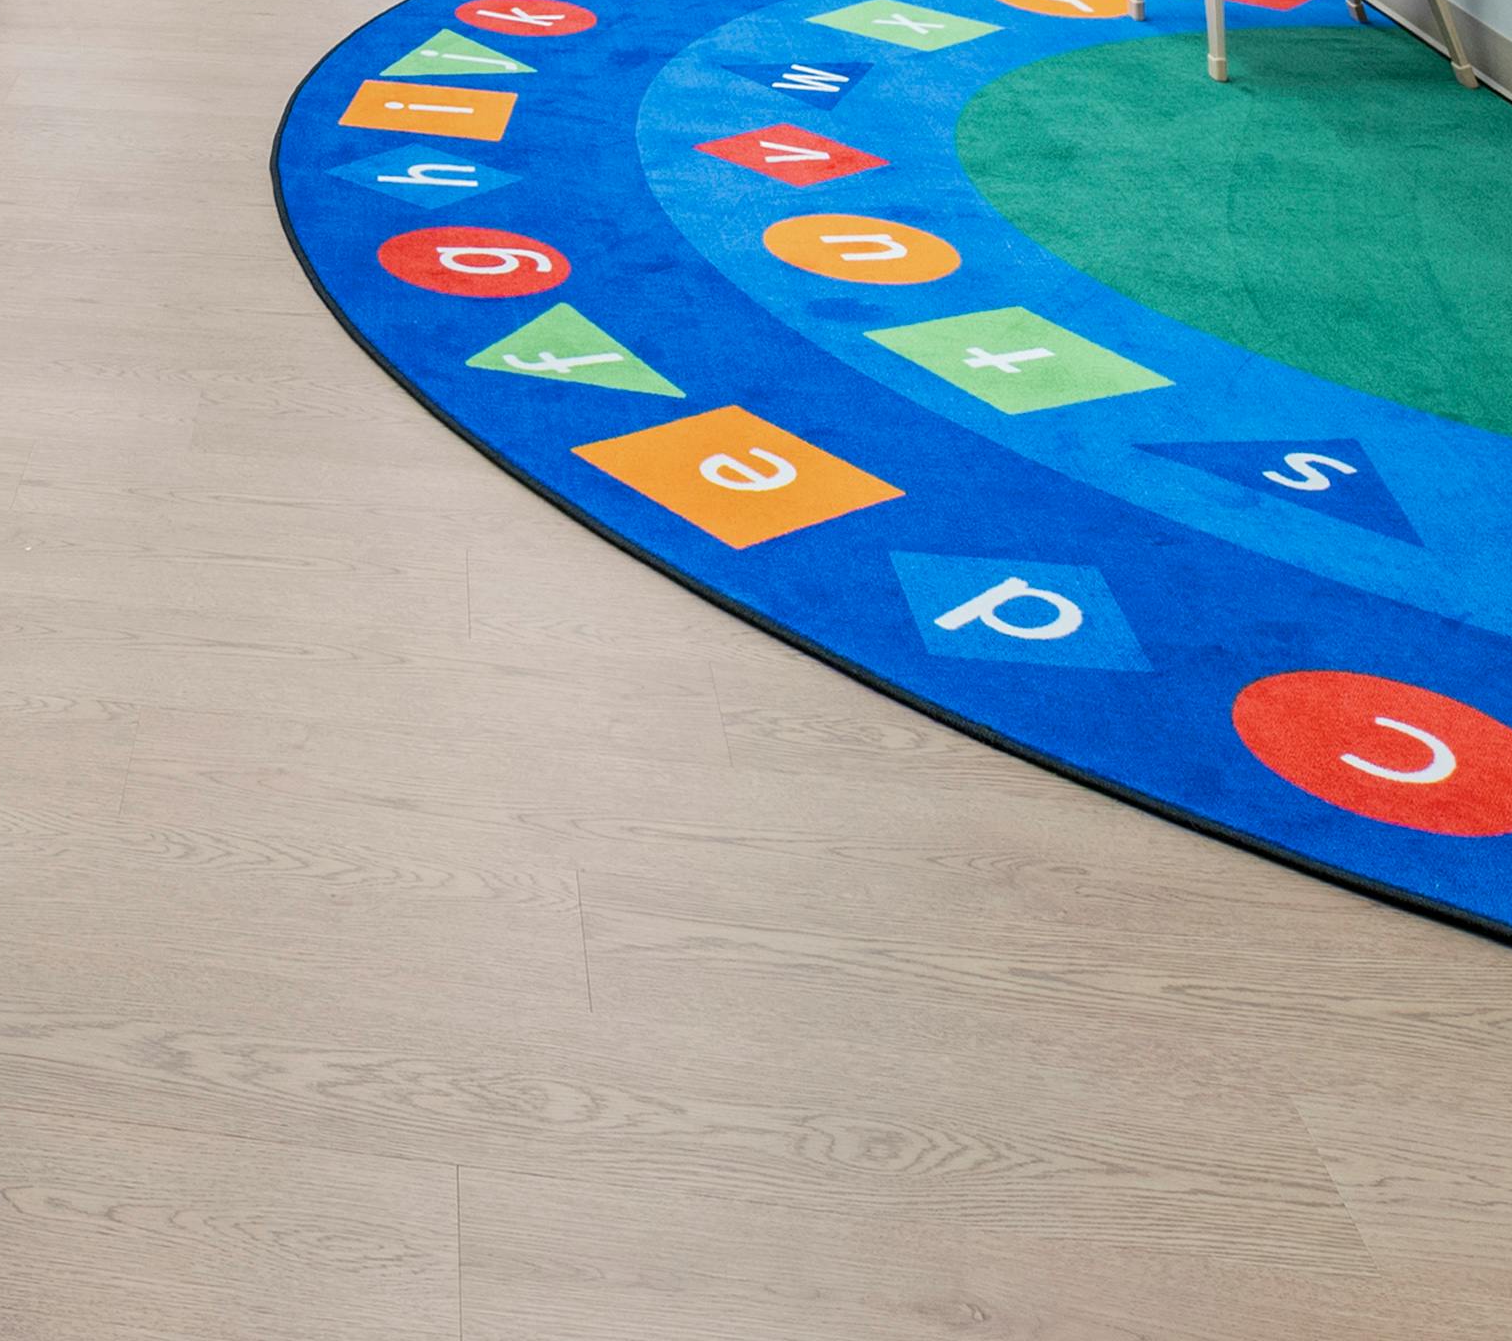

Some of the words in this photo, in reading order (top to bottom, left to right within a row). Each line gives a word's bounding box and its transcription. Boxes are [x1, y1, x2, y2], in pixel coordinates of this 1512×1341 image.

[476, 6, 566, 27] k
[501, 348, 627, 377] f
[962, 344, 1058, 375] t
[698, 444, 799, 494] e
